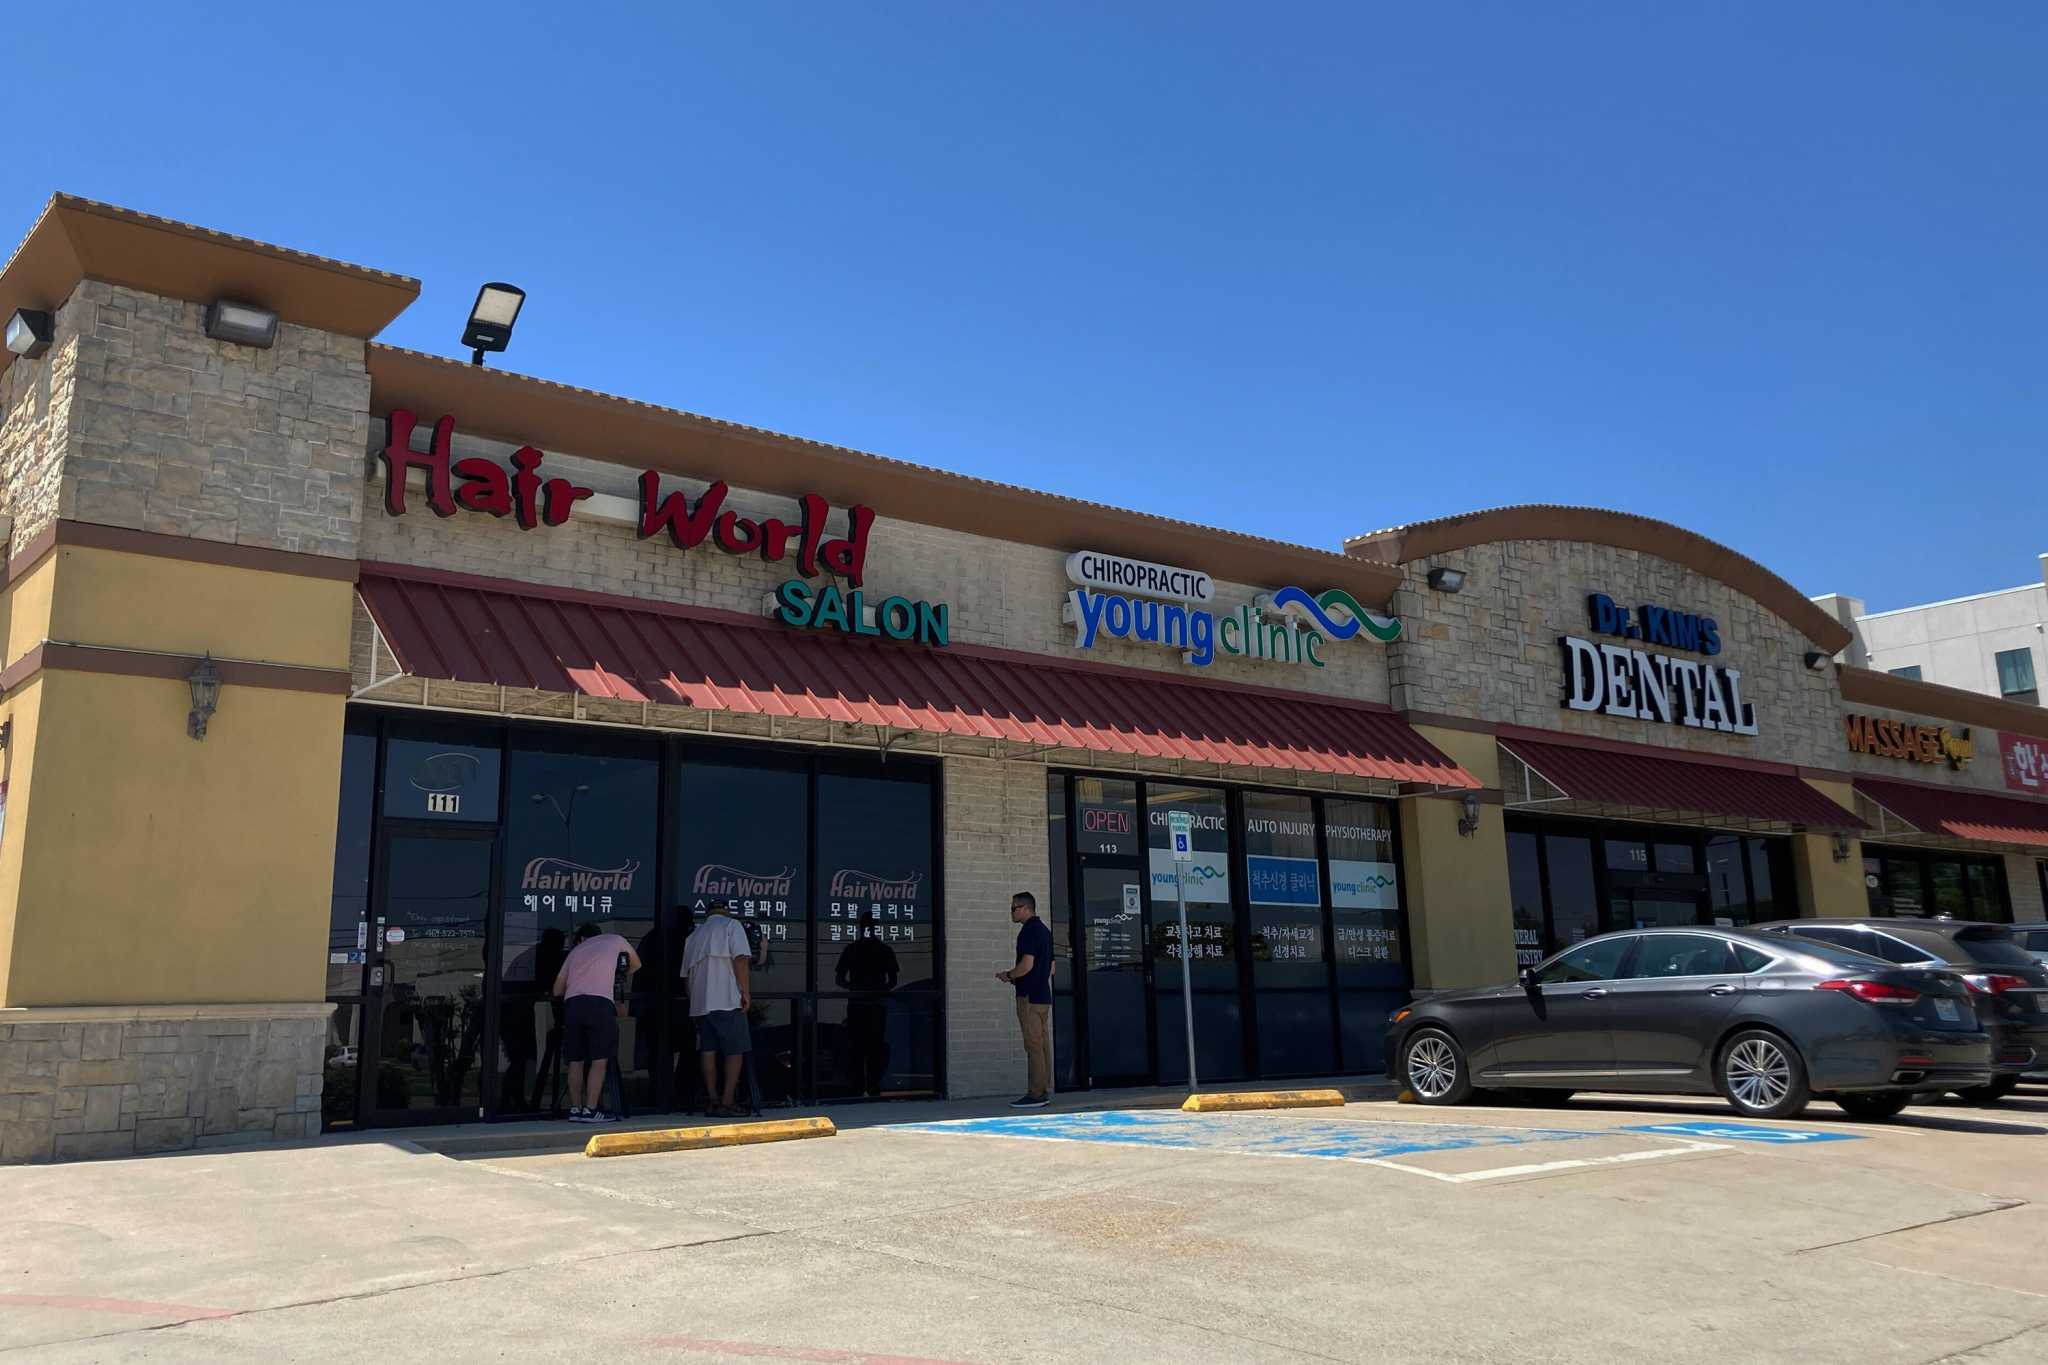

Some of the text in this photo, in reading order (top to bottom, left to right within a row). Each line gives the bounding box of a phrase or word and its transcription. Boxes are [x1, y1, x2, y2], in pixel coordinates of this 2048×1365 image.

[380, 409, 875, 588] Hair World
[1080, 555, 1206, 598] CHIROPRACTIC
[774, 578, 949, 647] SALON
[1590, 593, 1640, 639] Dr.
[1563, 635, 1759, 737] DENTAL
[1845, 714, 1946, 765] MASSAGE
[430, 793, 458, 813] 111
[1086, 810, 1129, 832] OPEN
[1150, 811, 1225, 831] CHIRACTIC
[1248, 818, 1315, 837] AUTO INJURY
[1325, 824, 1392, 842] PHYSIOTHERAPY
[1100, 843, 1118, 854] 113
[1629, 848, 1648, 863] 115
[523, 895, 613, 913] 헤어 매니큐
[694, 899, 788, 918] 스드열파마
[830, 902, 914, 920] 모발 클리닉
[1514, 929, 1539, 945] NERAL
